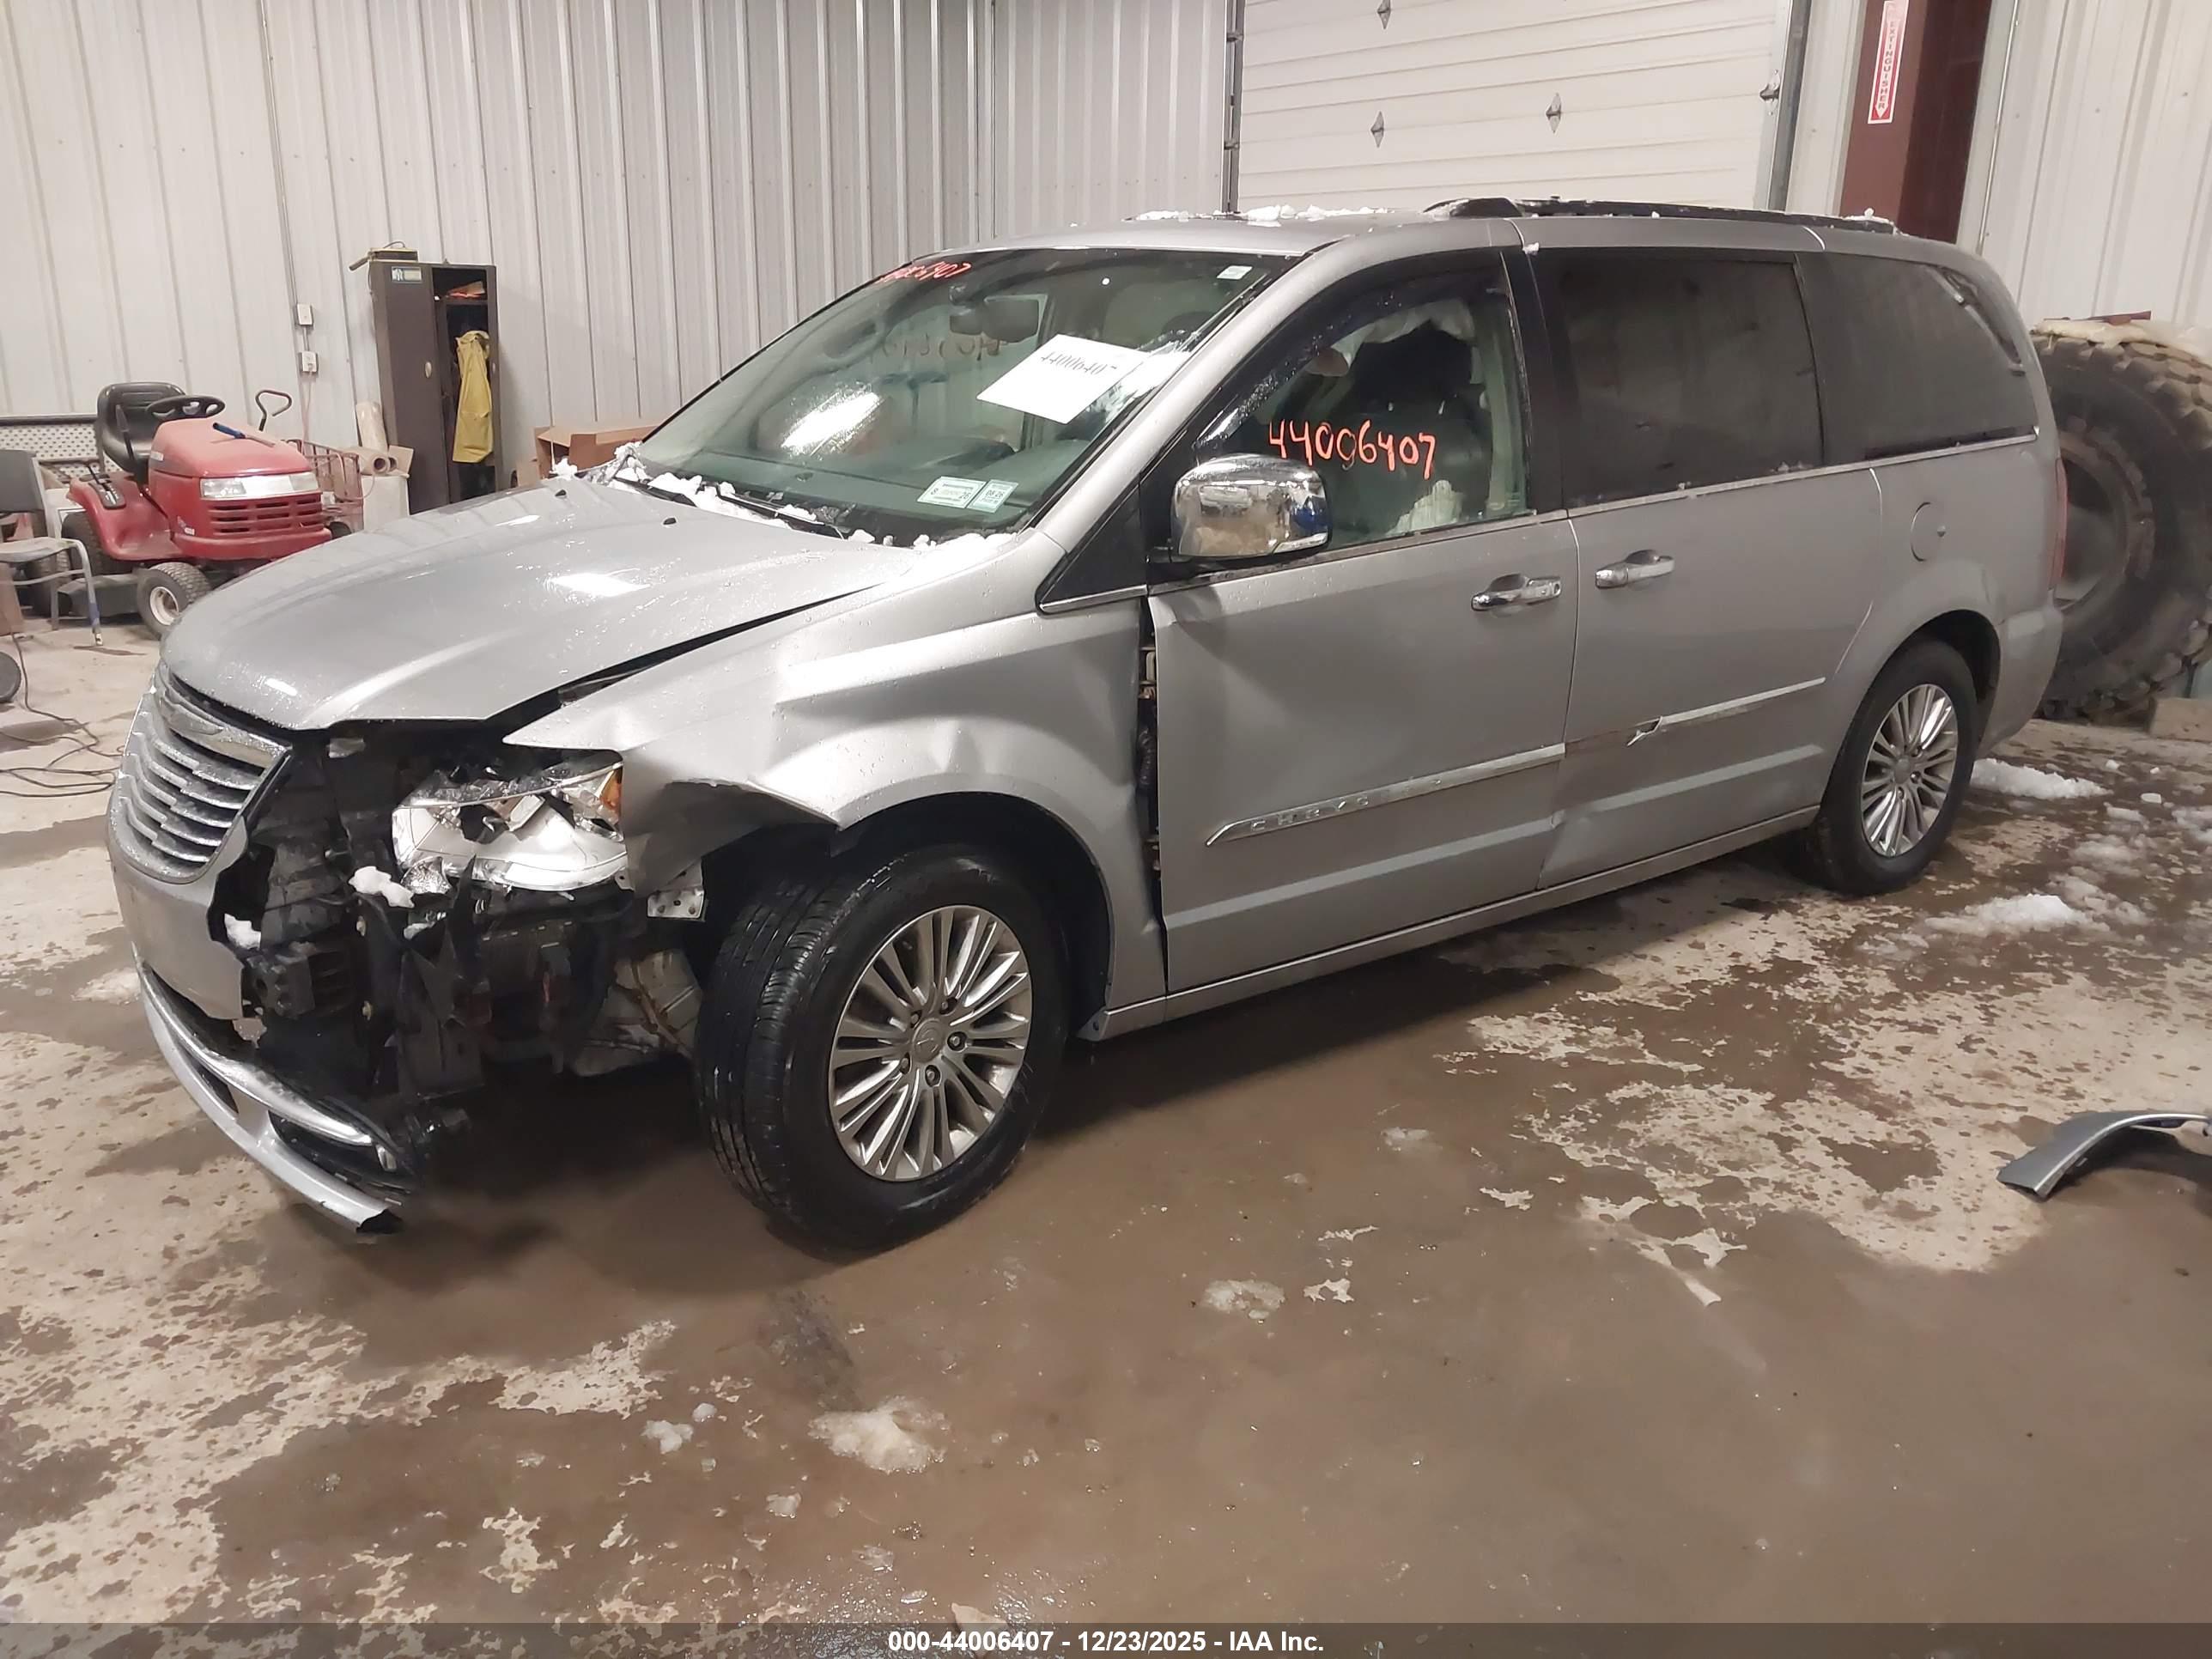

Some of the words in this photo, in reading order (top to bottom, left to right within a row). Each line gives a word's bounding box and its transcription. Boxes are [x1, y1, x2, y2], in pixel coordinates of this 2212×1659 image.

[1878, 21, 1896, 109] EXTINGUISHER
[1040, 350, 1118, 375] 4400640
[1268, 418, 1437, 480] 44006407
